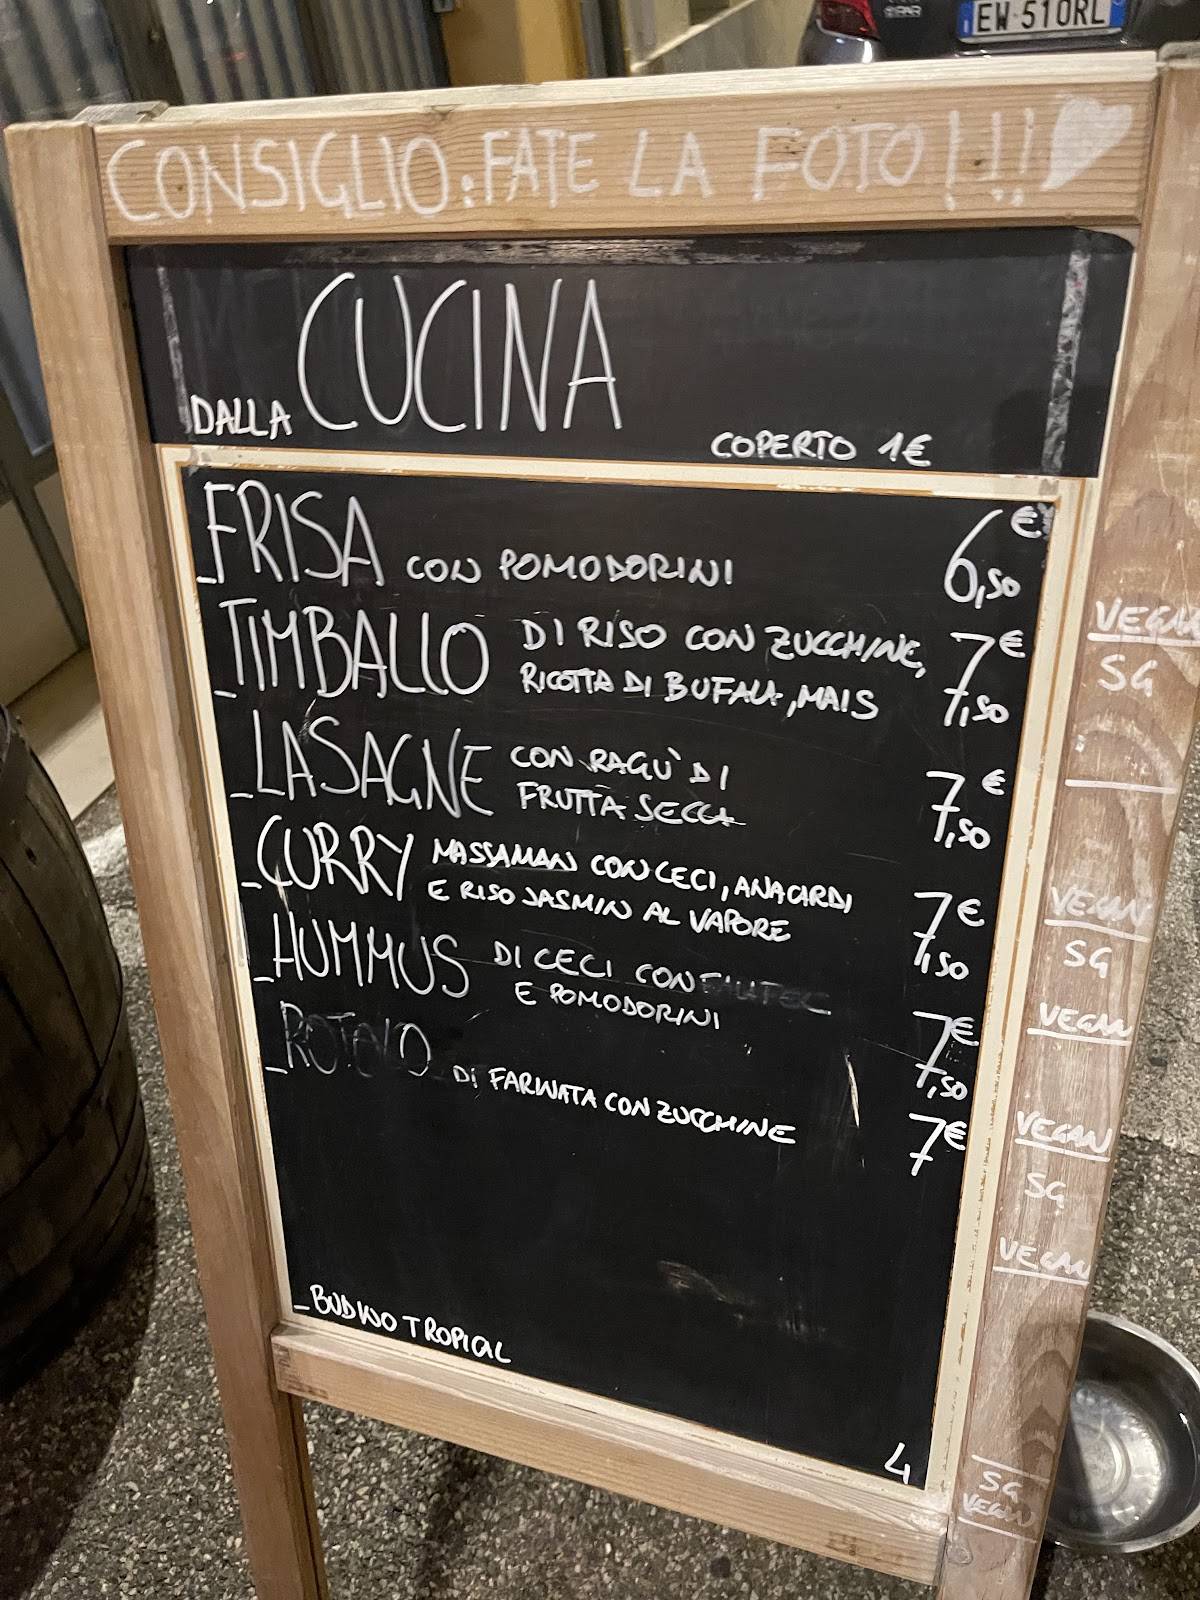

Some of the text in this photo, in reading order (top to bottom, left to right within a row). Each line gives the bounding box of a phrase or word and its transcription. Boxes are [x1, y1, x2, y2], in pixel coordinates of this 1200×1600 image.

[481, 128, 600, 208] FATE
[627, 127, 714, 200] LA
[190, 271, 622, 439] DALLA CUCINA
[710, 430, 932, 467] COPERTO 1€
[204, 479, 733, 588] FRISA CON POMODORINI
[218, 597, 490, 699] TIMBALLO
[521, 616, 564, 651] DI
[576, 615, 667, 650] RISO
[684, 623, 756, 653] CON
[519, 661, 615, 694] RICOTTA
[623, 668, 653, 698] DI
[1097, 654, 1158, 697] SG
[252, 709, 495, 818] LASAGNE
[510, 744, 574, 769] CON
[689, 761, 730, 791] DI
[516, 781, 627, 821] FRUTTA
[256, 814, 414, 901] CURRY
[431, 837, 579, 873] MASSAMAN
[591, 854, 651, 881] CON
[733, 874, 853, 914] ANACARDI
[427, 879, 792, 943] E RISO JASMIN AL VAPORE
[271, 910, 470, 999] HUMMUS
[493, 940, 522, 969] DI
[533, 948, 612, 979] CECI
[635, 963, 697, 994] CON
[1063, 939, 1112, 979] SG
[514, 981, 538, 1007] E
[549, 981, 721, 1031] POMODORINI
[1039, 1002, 1132, 1038] VEGAN
[604, 1092, 651, 1118] CON
[655, 1100, 797, 1145] ZUCCHINE
[1016, 1110, 1113, 1153] VEGAN
[1025, 1173, 1066, 1210] SG
[999, 1237, 1092, 1279] VEGAN
[884, 1442, 911, 1485] 4
[979, 1471, 1023, 1503] SG
